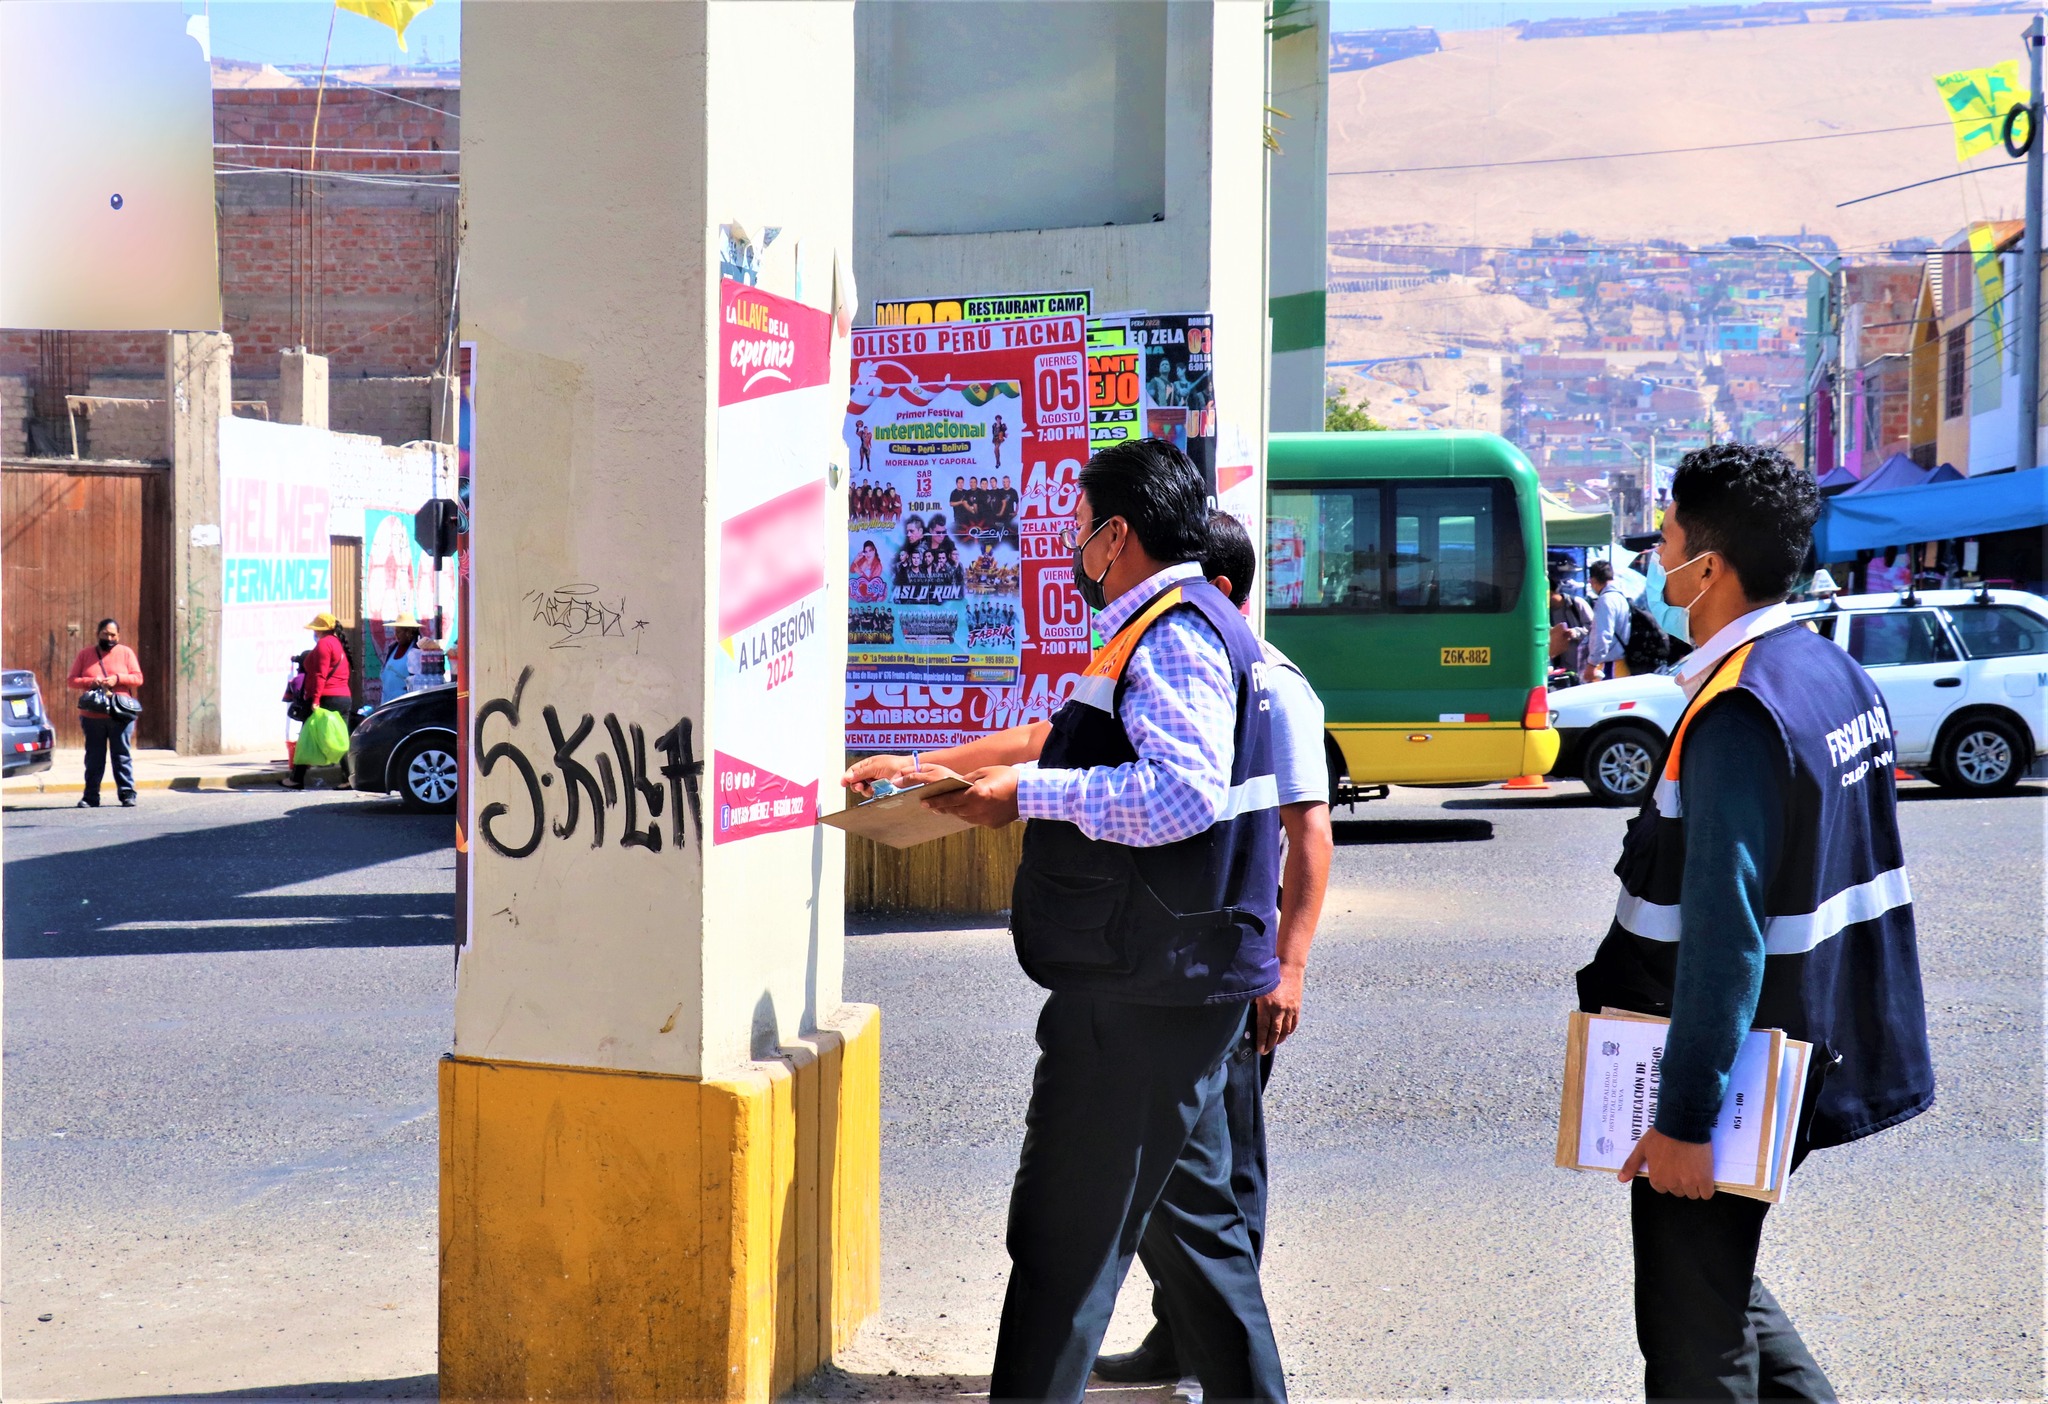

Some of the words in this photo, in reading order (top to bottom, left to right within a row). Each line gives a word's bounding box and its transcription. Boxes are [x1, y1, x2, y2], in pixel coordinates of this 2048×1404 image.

[969, 298, 1045, 316] RESTAURANT
[1048, 296, 1085, 312] CAMP.
[726, 305, 737, 325] LA
[737, 299, 769, 333] LLAVE
[768, 317, 779, 336] DE
[779, 321, 789, 339] LA
[938, 327, 991, 351] PERÚ
[1002, 320, 1076, 347] TACNA
[1151, 328, 1185, 344] ZELA
[1187, 328, 1212, 354] 03
[730, 339, 795, 376] esperanza
[1039, 355, 1077, 368] VIERNES
[1039, 368, 1081, 412] 05
[896, 411, 926, 421] Primer
[927, 408, 964, 418] Festival
[1041, 411, 1081, 424] AGOSTO
[874, 419, 986, 441] Internacional
[1037, 428, 1063, 442] 7:00
[1066, 426, 1086, 440] PM
[891, 444, 911, 453] Chile
[917, 443, 935, 454] Perú
[942, 443, 969, 453] Bolivia
[885, 459, 929, 467] MORENADA
[939, 457, 977, 465] CAPORAL
[916, 478, 932, 492] 13
[908, 501, 925, 512] 1:00
[926, 502, 943, 512] p.m.
[224, 477, 330, 553] HELMER
[1022, 521, 1048, 532] ZELA
[1050, 520, 1061, 532] N°
[223, 558, 330, 603] FERNANDEZ
[1042, 583, 1084, 625] 05
[739, 641, 749, 673] A
[752, 632, 768, 666] LA
[771, 601, 815, 656] REGIÓN
[1044, 626, 1083, 637] AGOSTO
[1040, 642, 1066, 654] 7:00
[1068, 641, 1088, 654] PM
[896, 654, 903, 663] de
[1443, 649, 1488, 664] Z6K-882
[766, 650, 794, 691] 2022
[845, 734, 876, 744] VENTA
[878, 734, 891, 744] DE
[894, 733, 949, 744] ENTRADAS:
[1635, 1061, 1646, 1075] DE
[1649, 1046, 1663, 1083] CARGOS
[1602, 1071, 1611, 1123] MUNICIPALIDAD
[1611, 1089, 1617, 1098] DE
[1648, 1086, 1660, 1099] DE
[1735, 1092, 1744, 1106] 100
[1630, 1076, 1645, 1141] NOTIFICACIÓN
[1733, 1116, 1742, 1130] 051
